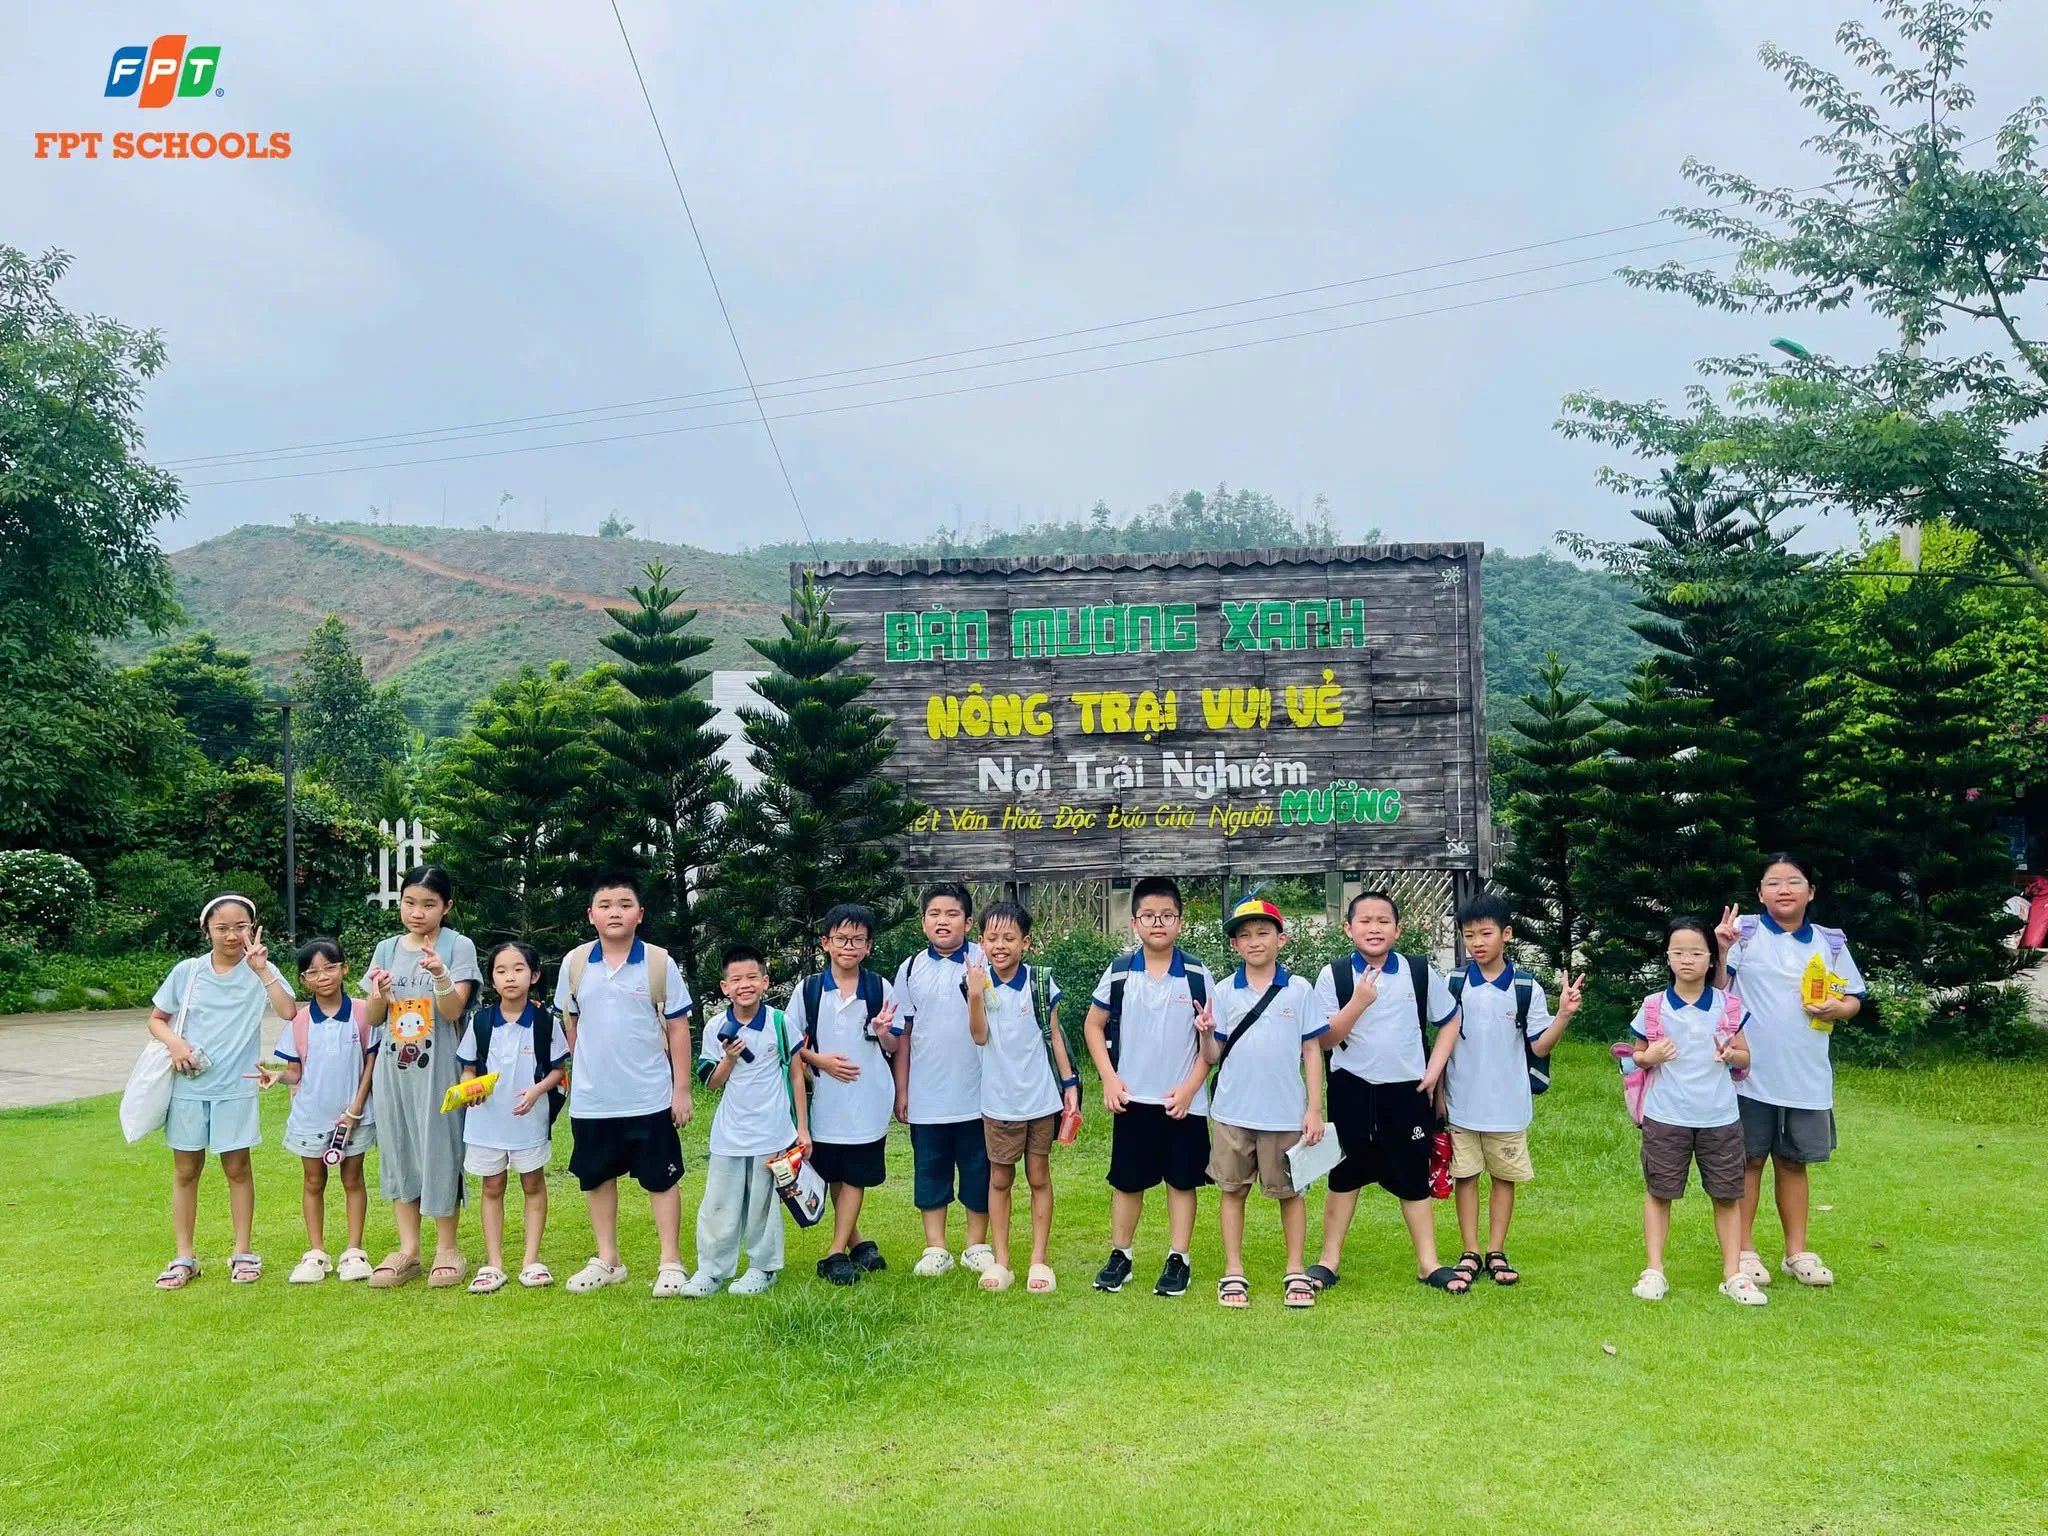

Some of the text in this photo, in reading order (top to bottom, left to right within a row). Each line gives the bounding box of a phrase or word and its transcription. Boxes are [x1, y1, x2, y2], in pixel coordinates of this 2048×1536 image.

[884, 599, 1366, 662] BẢN MƯỜNG XANH
[926, 668, 1344, 741] NÔNG TRẠI VUI VẺ
[978, 751, 1307, 800] Nơi Trải Nghiệm
[906, 807, 941, 832] ét
[948, 807, 988, 831] Văn
[1052, 805, 1097, 835] Độc
[1155, 804, 1195, 829] Của
[1279, 779, 1401, 827] MƯỜNG
